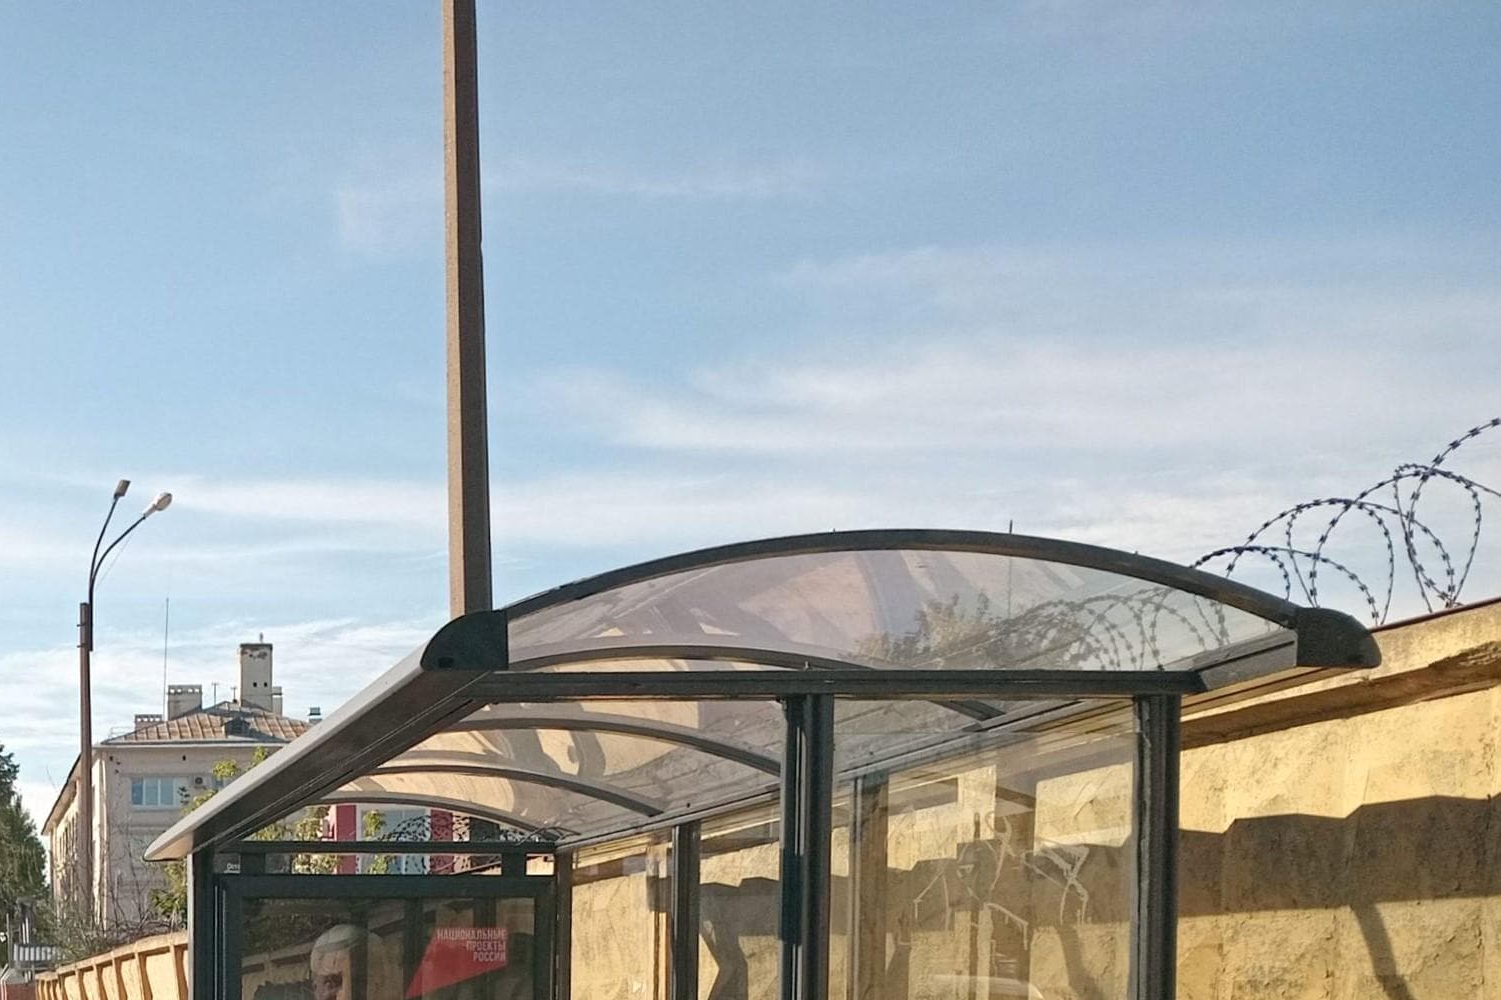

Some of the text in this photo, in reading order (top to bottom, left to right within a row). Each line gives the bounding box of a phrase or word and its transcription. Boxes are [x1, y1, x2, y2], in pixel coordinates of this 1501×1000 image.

[437, 928, 507, 940] НАЦИОНАЛЬНЫЕ
[466, 940, 506, 951] ПРОЕКТЫ
[473, 951, 506, 961] РОССИИ
